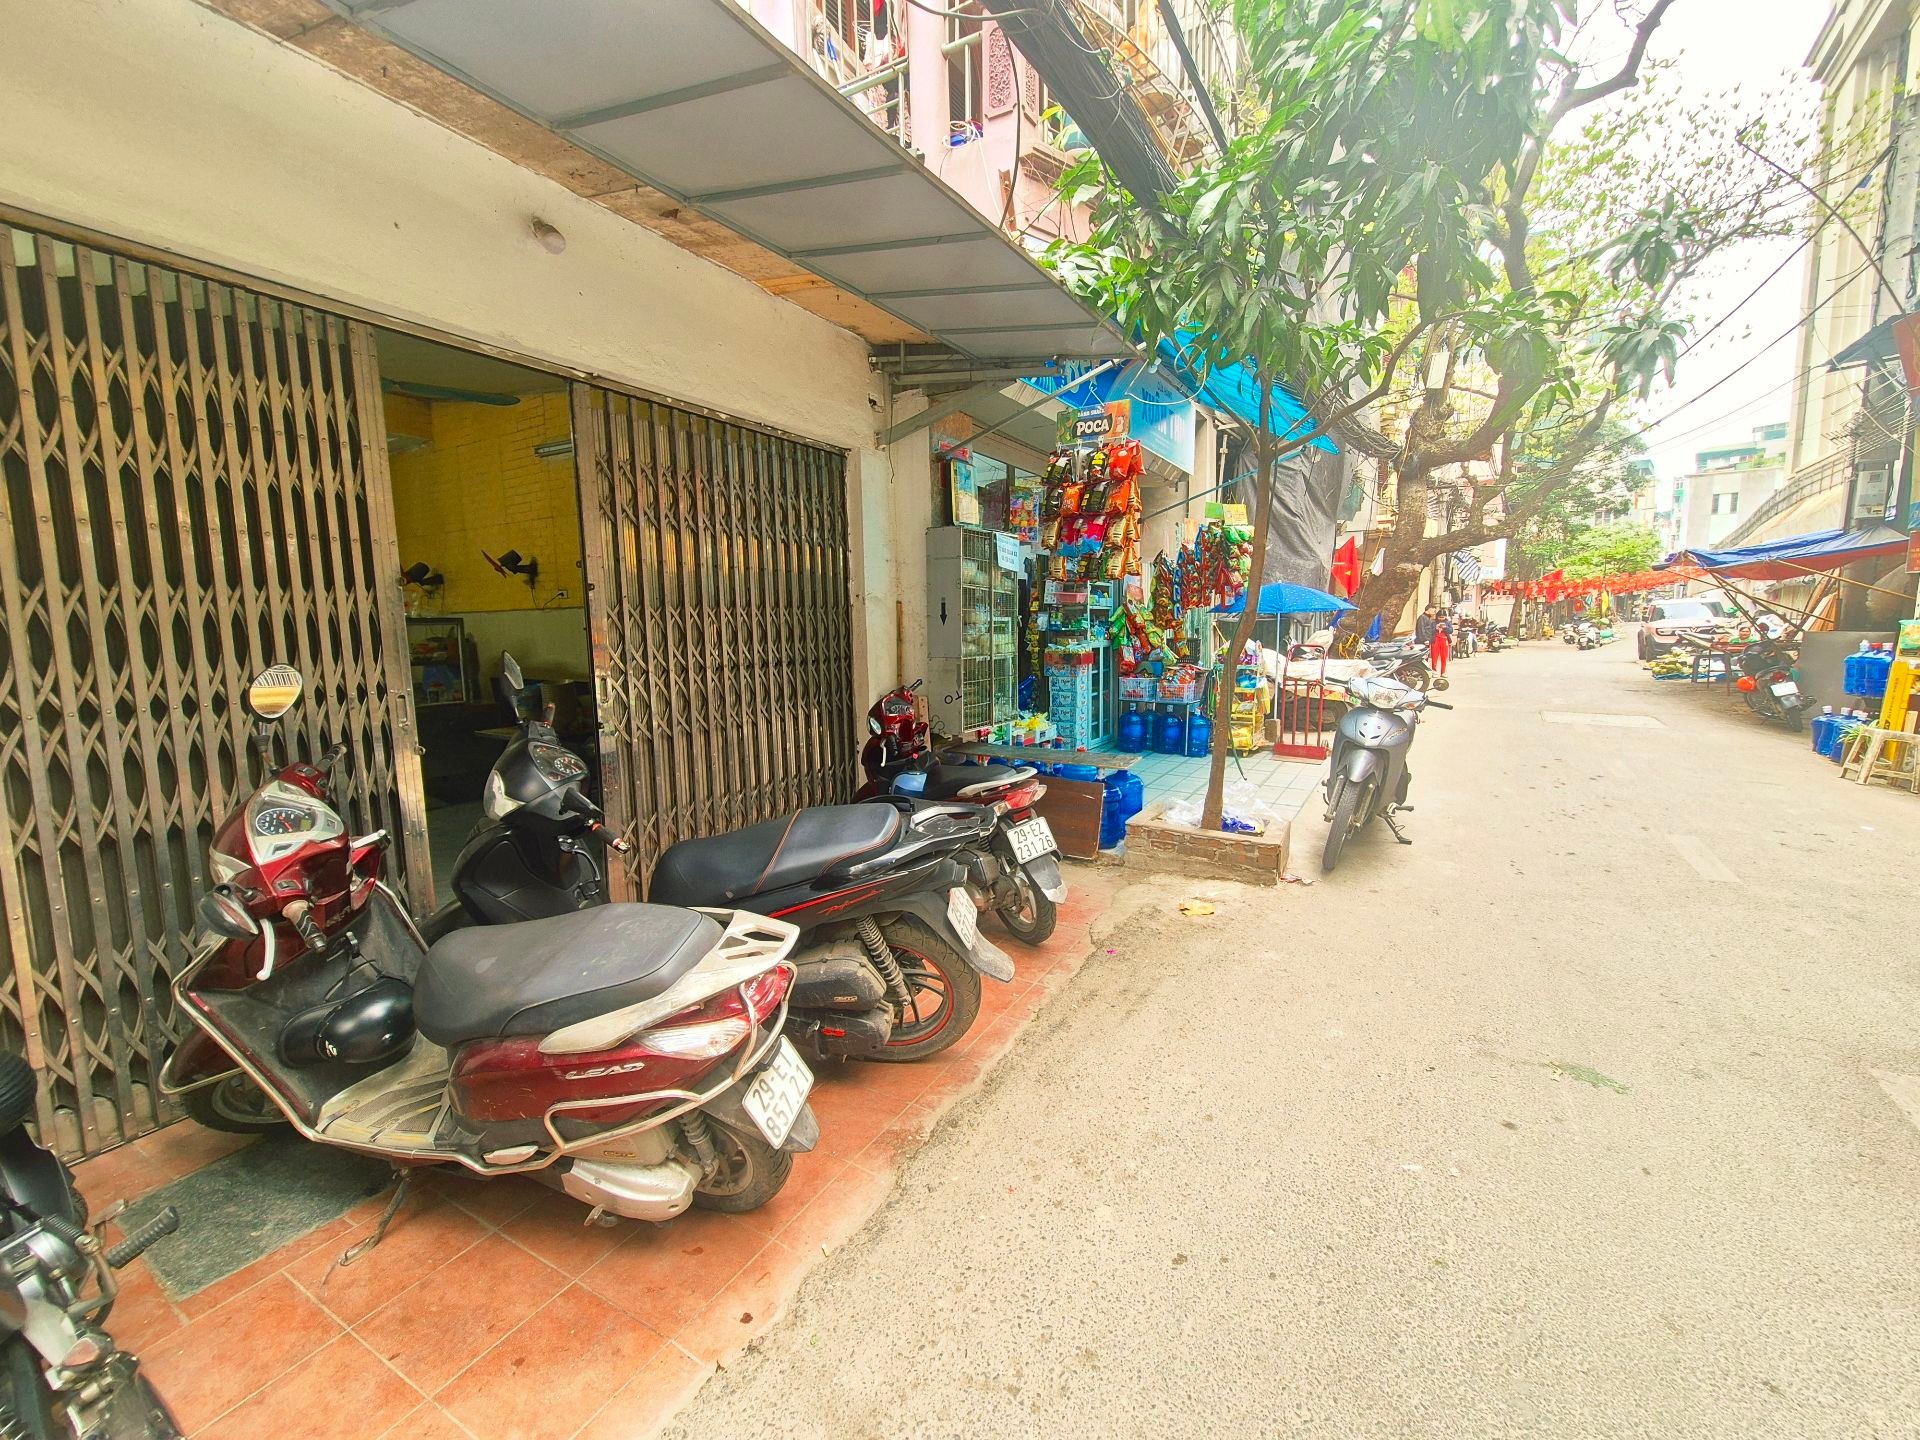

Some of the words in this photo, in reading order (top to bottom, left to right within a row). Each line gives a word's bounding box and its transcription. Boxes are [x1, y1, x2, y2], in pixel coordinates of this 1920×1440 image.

[1076, 418, 1109, 436] POCA
[1014, 822, 1045, 843] 29-E2
[1017, 835, 1053, 860] 231.26
[565, 1062, 645, 1079] LEAD
[766, 1064, 809, 1139] 857.21
